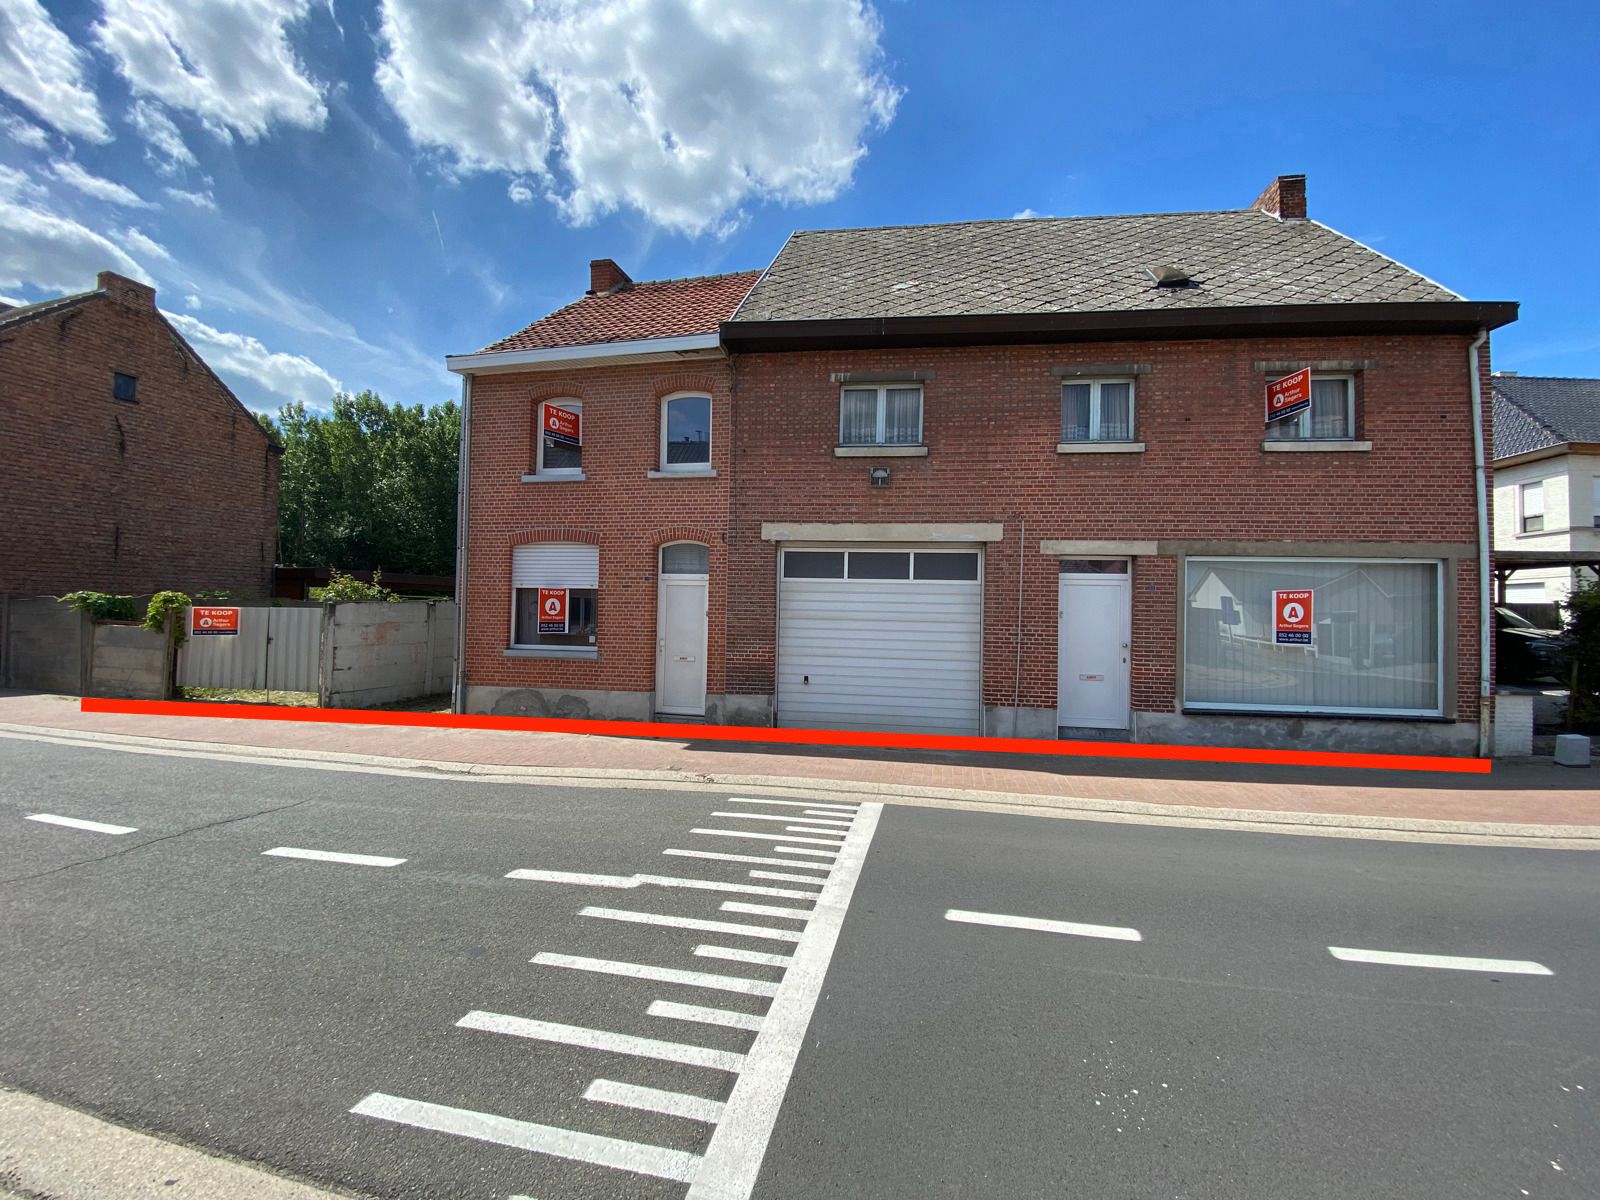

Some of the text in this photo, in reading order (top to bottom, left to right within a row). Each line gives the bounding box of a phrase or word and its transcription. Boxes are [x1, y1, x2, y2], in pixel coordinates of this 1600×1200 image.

[1272, 374, 1303, 392] TE KOOP
[549, 407, 576, 420] TE KOOP
